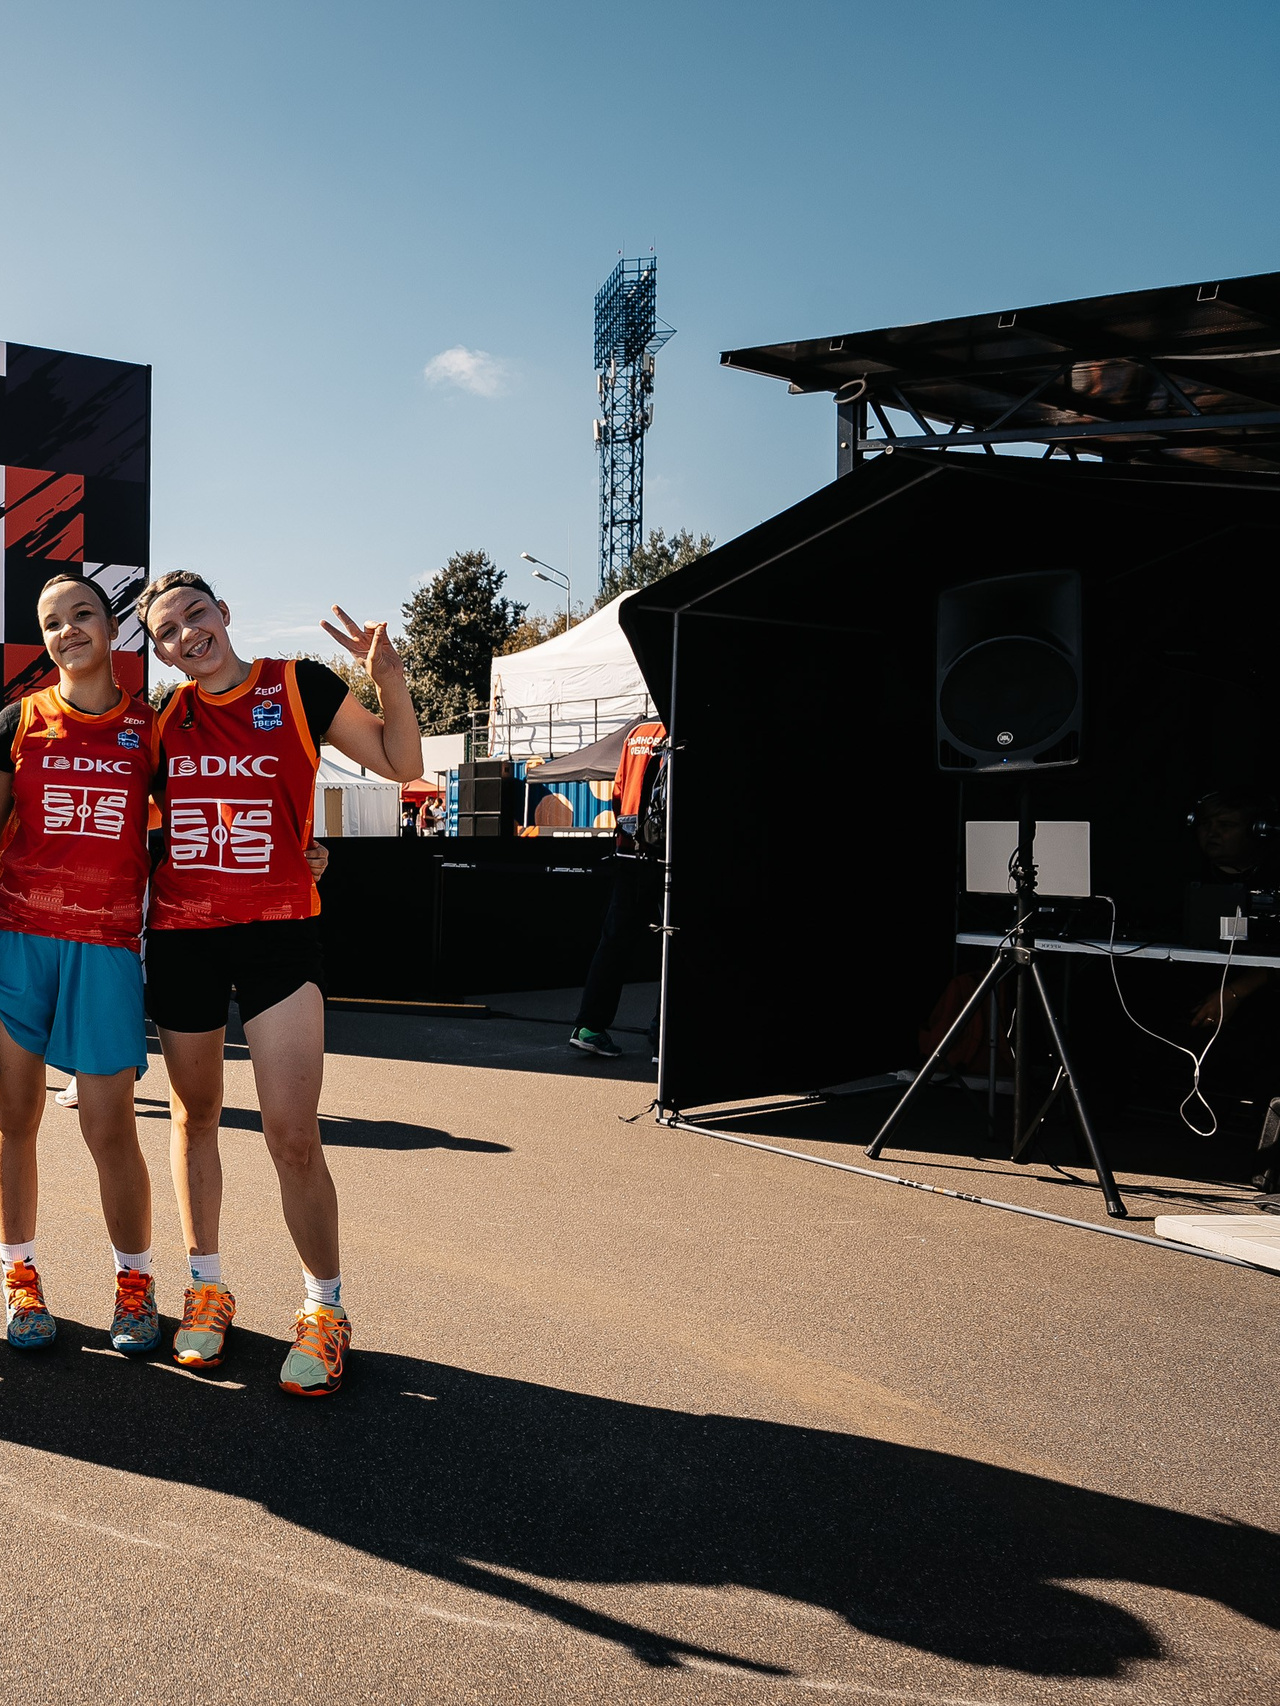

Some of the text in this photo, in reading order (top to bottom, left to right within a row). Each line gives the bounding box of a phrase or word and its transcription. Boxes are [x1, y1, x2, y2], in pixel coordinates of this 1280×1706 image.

[252, 719, 283, 728] ТВЕРЬ
[73, 757, 132, 774] DKC
[200, 755, 279, 778] DKC
